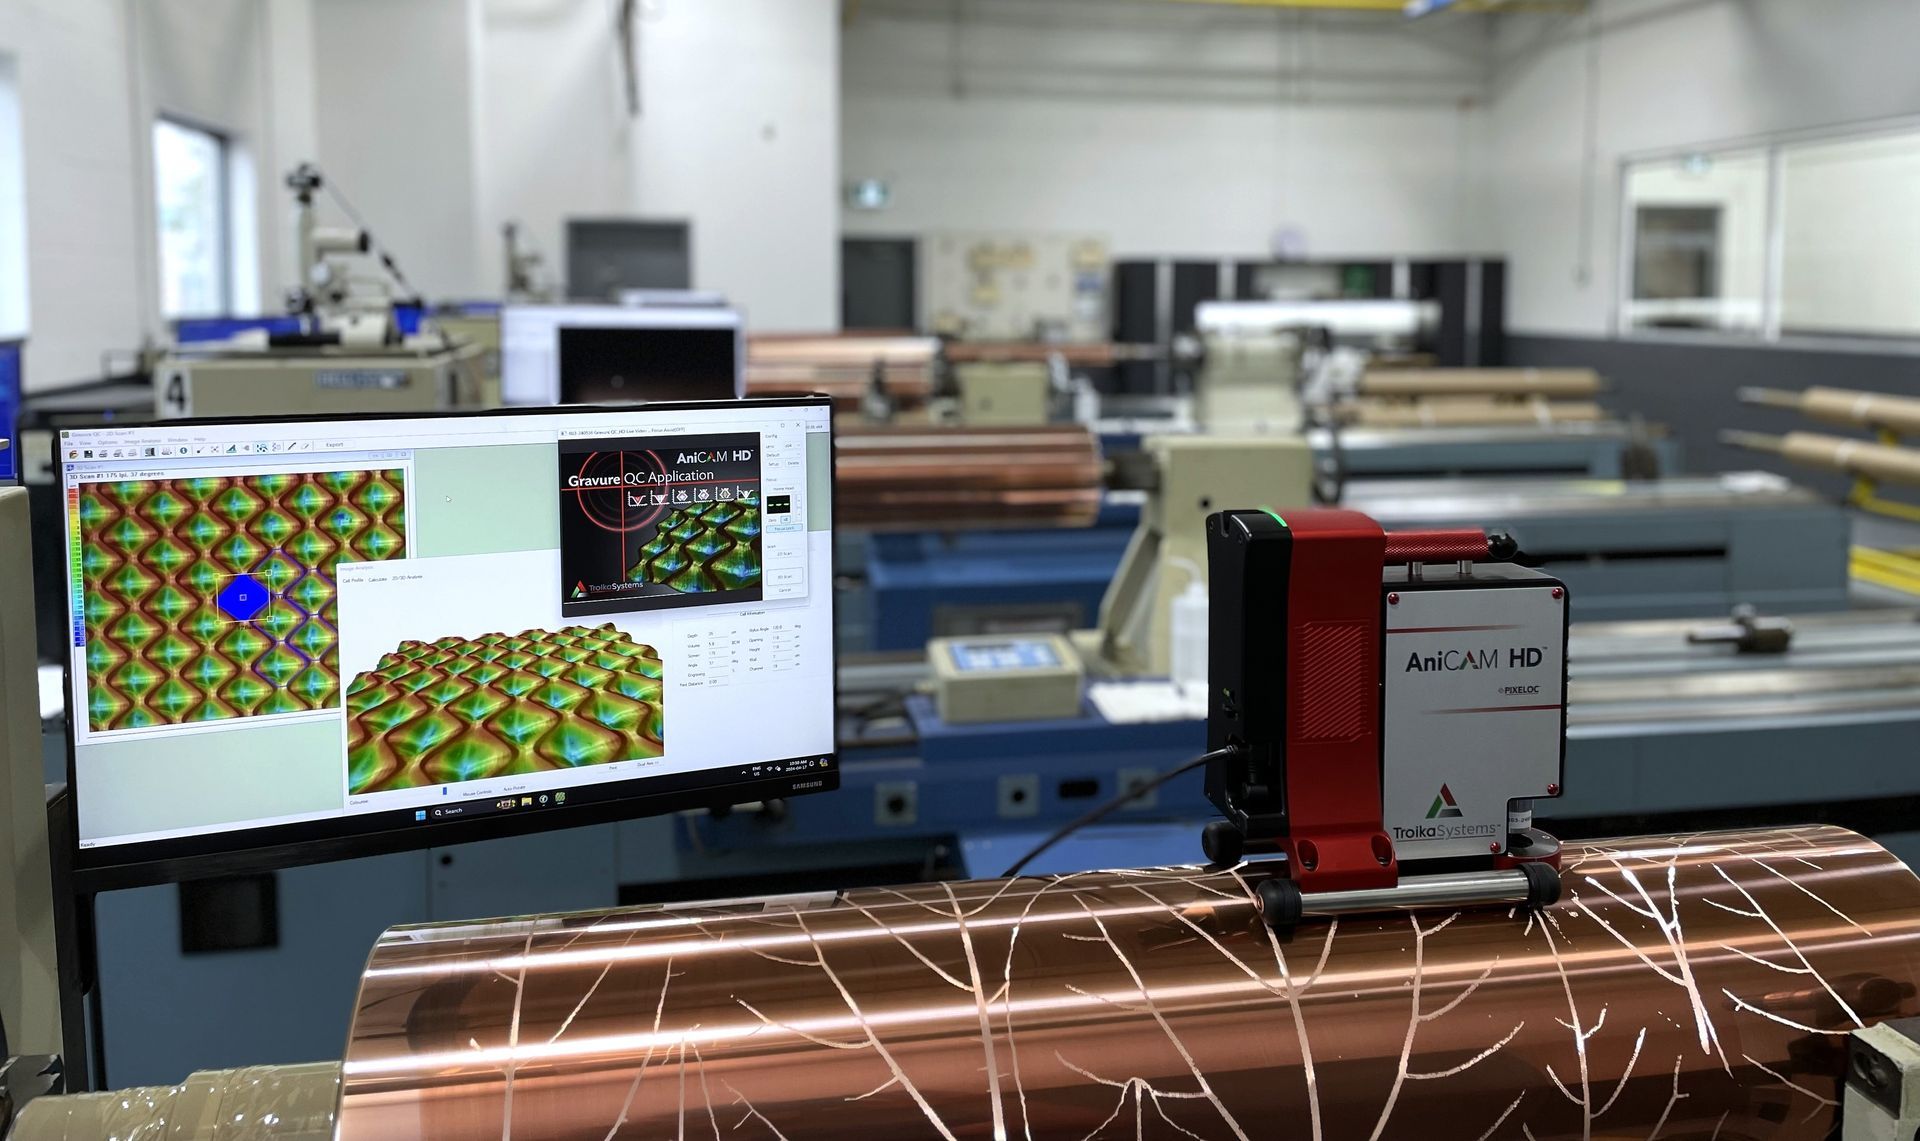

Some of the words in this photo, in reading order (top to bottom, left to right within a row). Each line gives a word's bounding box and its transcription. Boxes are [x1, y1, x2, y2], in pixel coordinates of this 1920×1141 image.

[168, 375, 184, 411] 4
[676, 451, 728, 464] AniCAM
[140, 470, 164, 478] degrees
[568, 475, 620, 487] Gravure
[624, 472, 645, 486] QC
[647, 468, 714, 486] Application
[1405, 649, 1498, 672] AniCAM
[1504, 685, 1540, 694] PIXELOC
[792, 780, 823, 790] SAMSUNG
[444, 807, 463, 815] Search
[1393, 824, 1496, 838] TroikaSystems
